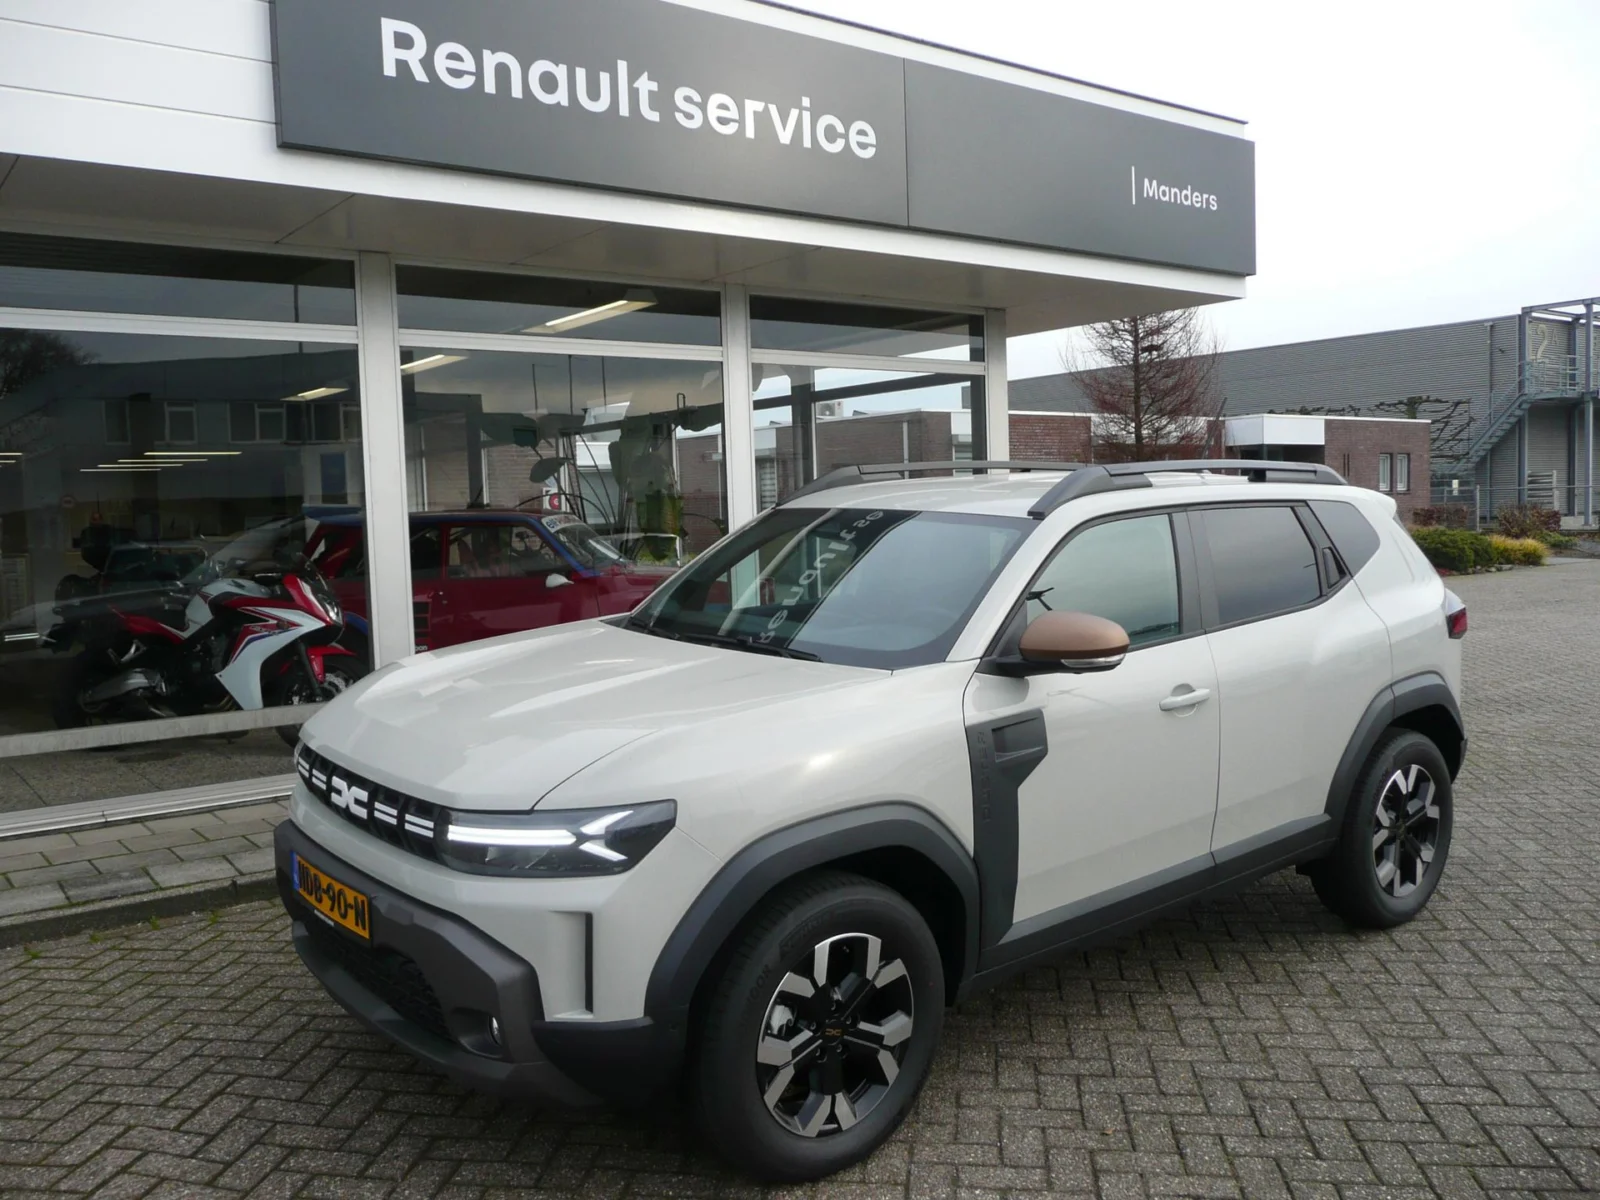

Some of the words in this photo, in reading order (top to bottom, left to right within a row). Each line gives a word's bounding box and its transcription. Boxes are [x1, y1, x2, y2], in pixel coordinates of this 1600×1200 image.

[379, 17, 662, 122] Renault
[673, 84, 879, 161] service
[1143, 177, 1218, 211] Manders
